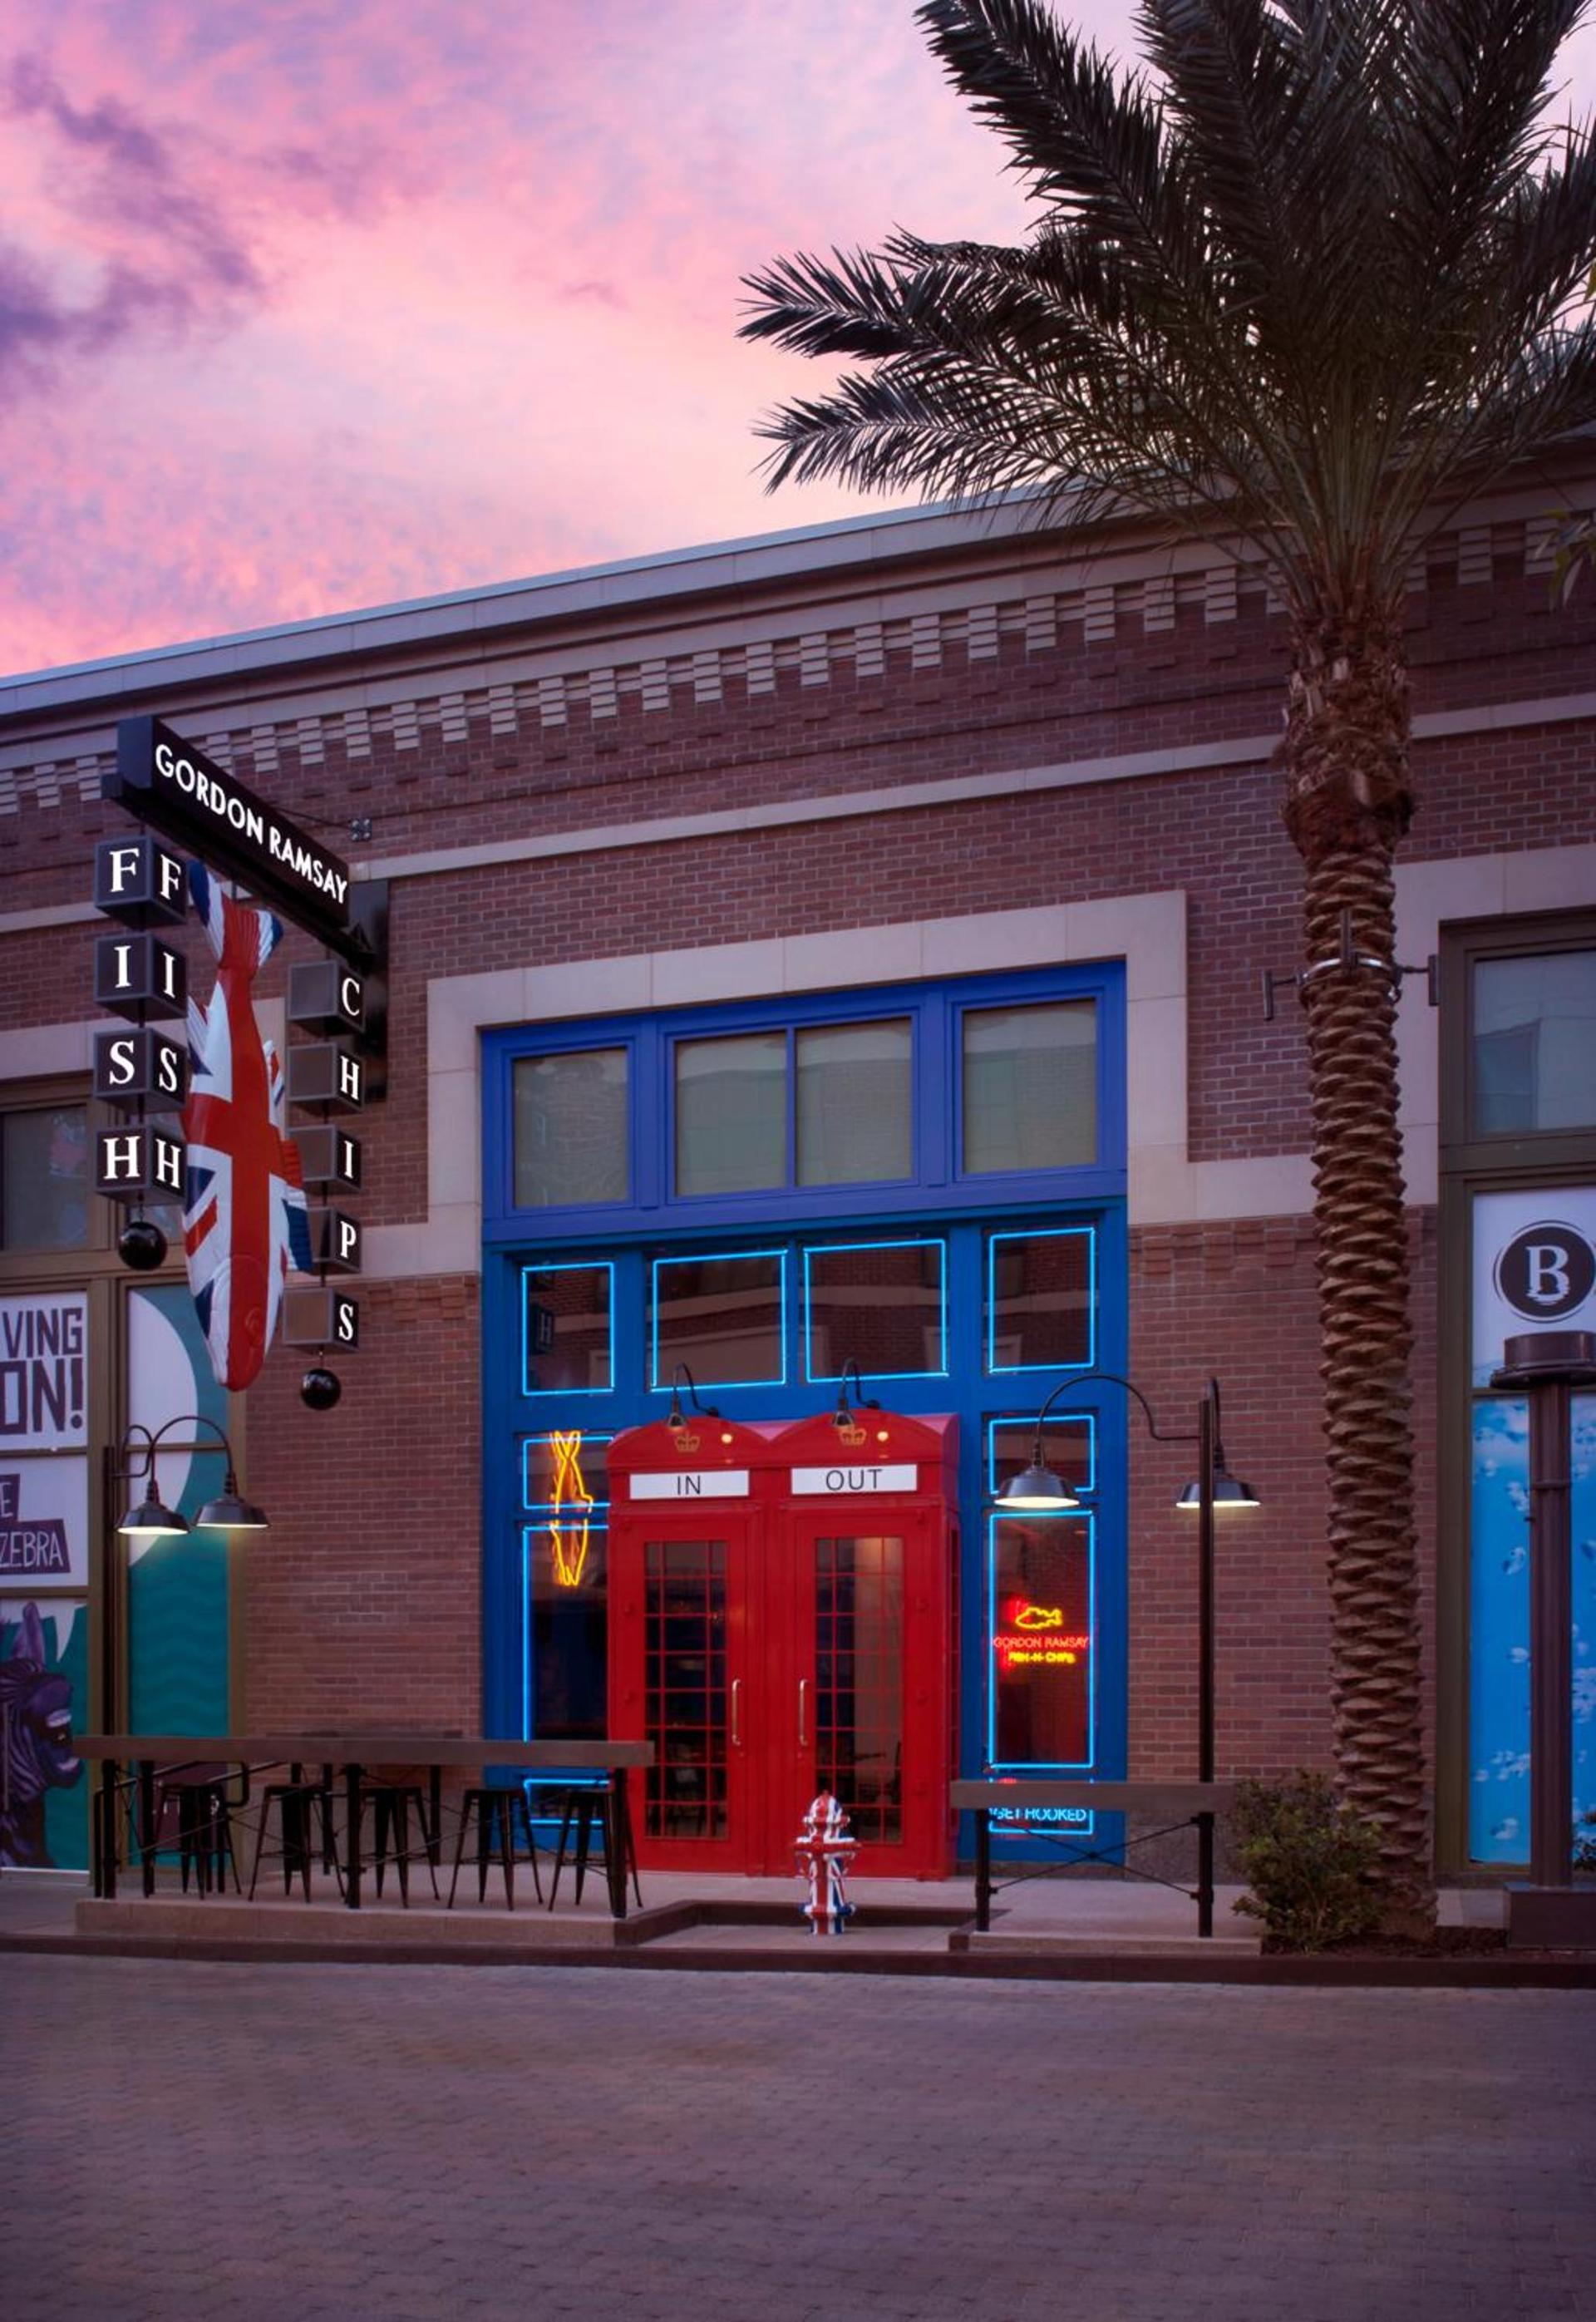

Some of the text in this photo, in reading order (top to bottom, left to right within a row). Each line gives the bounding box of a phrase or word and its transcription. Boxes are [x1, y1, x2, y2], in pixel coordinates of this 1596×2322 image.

[155, 743, 348, 905] GORDON RAMSAY
[676, 1474, 702, 1496] IN
[825, 1468, 883, 1491] OUT
[0, 1530, 64, 1568] ZEBRA
[993, 1635, 1089, 1649] GORDON RAMSAY
[1024, 1807, 1087, 1822] HOOKED
